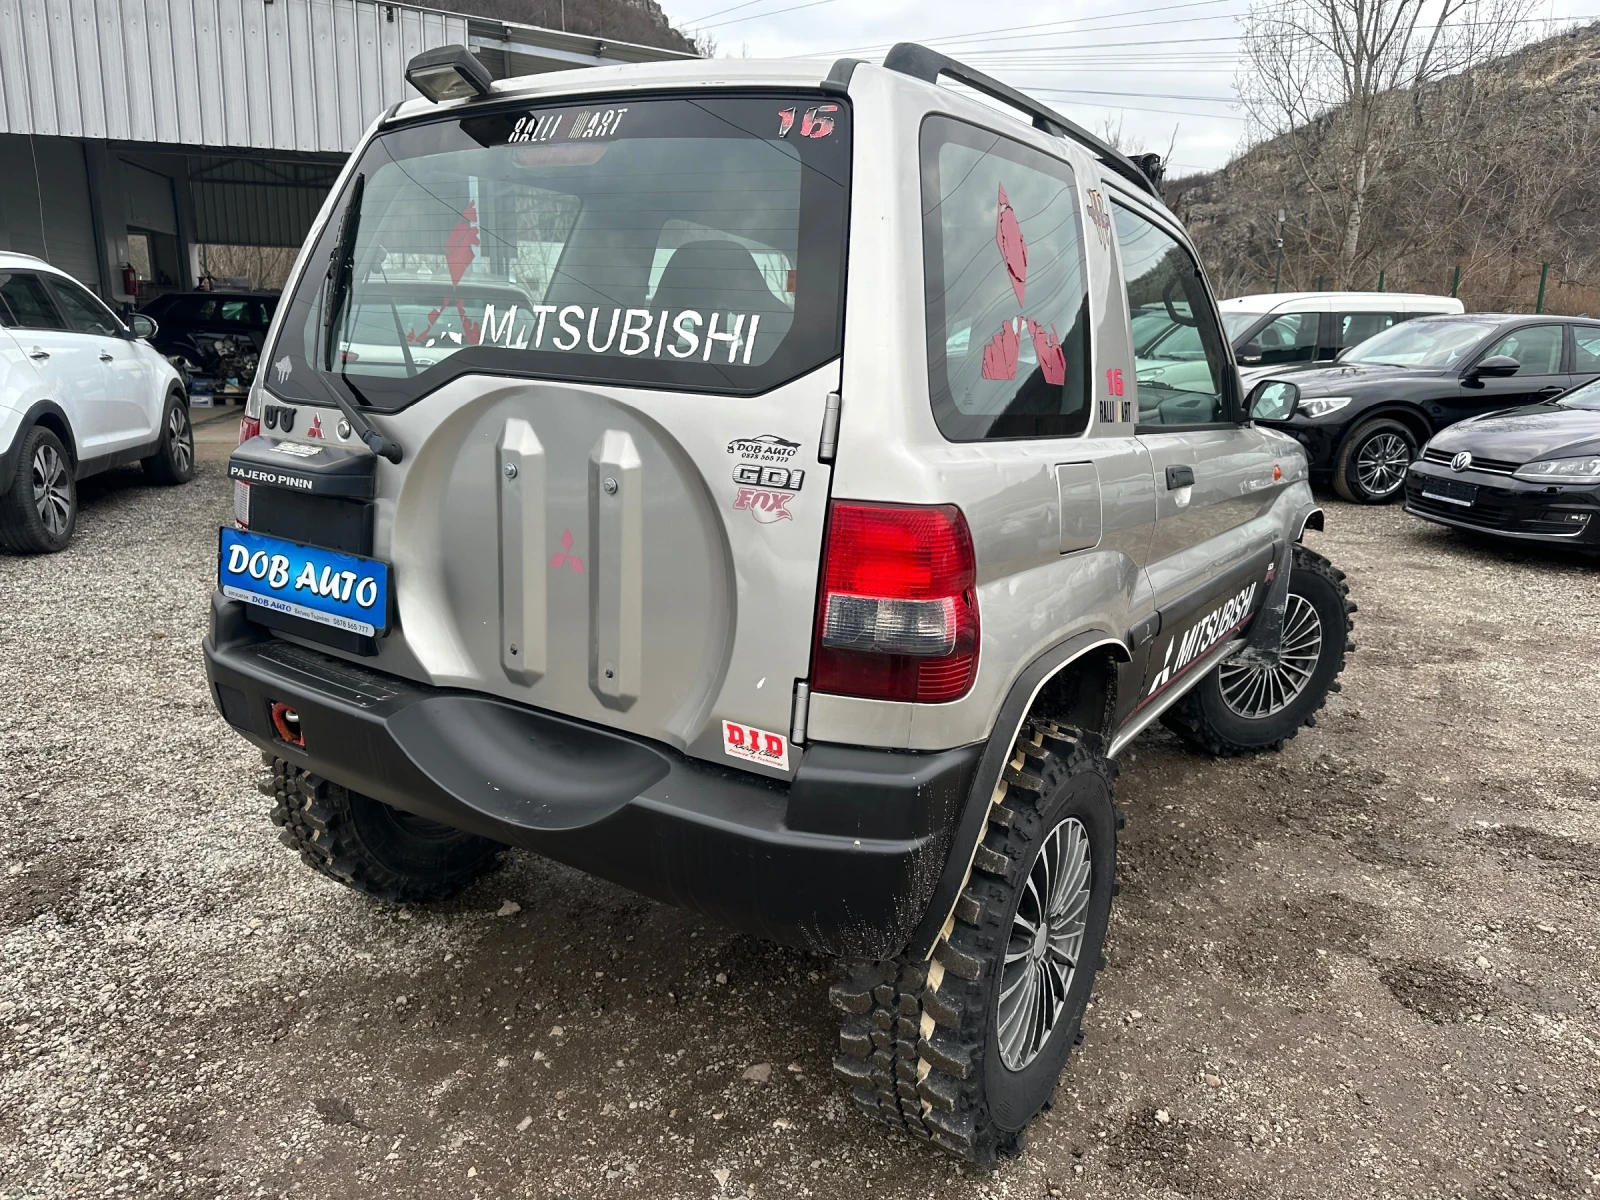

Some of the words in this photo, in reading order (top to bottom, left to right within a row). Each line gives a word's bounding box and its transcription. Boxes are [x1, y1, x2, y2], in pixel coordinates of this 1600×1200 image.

[507, 115, 563, 143] RALLI
[582, 108, 628, 138] ART
[778, 105, 838, 138] 16
[1106, 368, 1124, 396] 16
[737, 443, 762, 453] DOB
[764, 447, 796, 457] AUTO
[741, 452, 759, 460] 0878
[760, 454, 774, 462] 565
[230, 466, 276, 483] PAJERO
[277, 474, 313, 490] PININ
[732, 463, 805, 491] GDI
[733, 487, 796, 514] FOX
[228, 544, 290, 589] DOB
[295, 561, 378, 607] AUTO
[251, 595, 269, 607] DOB
[270, 601, 292, 612] AUTO
[332, 618, 346, 628] 0878
[347, 621, 357, 631] 565
[358, 624, 369, 633] 777
[1172, 581, 1257, 673] MITSUBISHI
